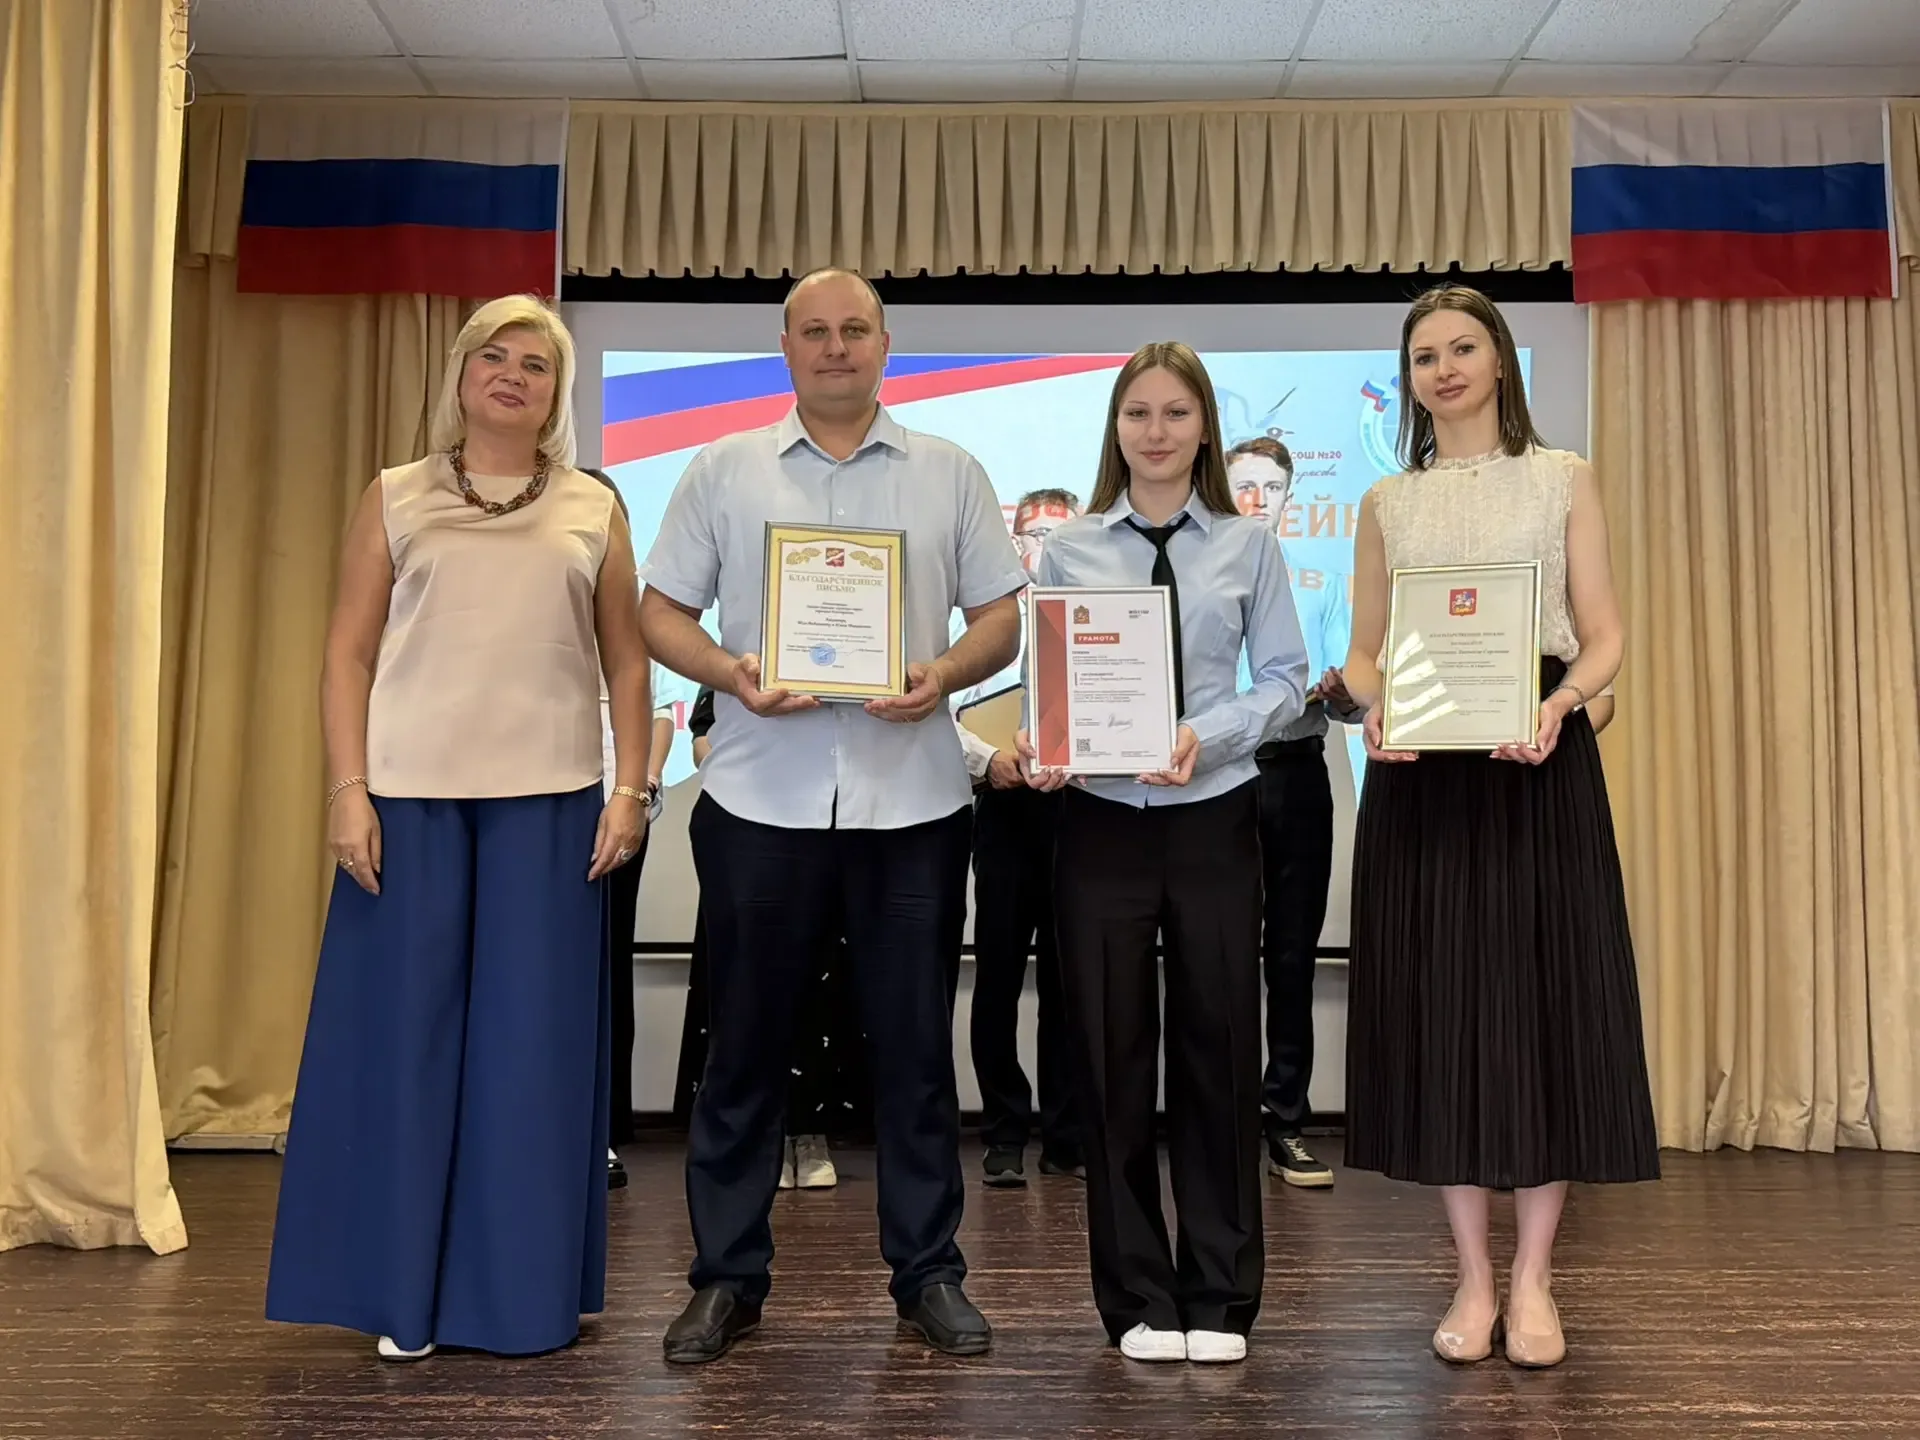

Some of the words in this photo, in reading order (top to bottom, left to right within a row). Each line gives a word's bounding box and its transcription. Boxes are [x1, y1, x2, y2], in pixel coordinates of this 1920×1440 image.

[1291, 451, 1316, 460] СОШ
[1317, 450, 1342, 460] №20
[789, 574, 883, 587] БЛАГОДАРСТВЕННОЕ
[816, 584, 856, 593] ПИСЬМО
